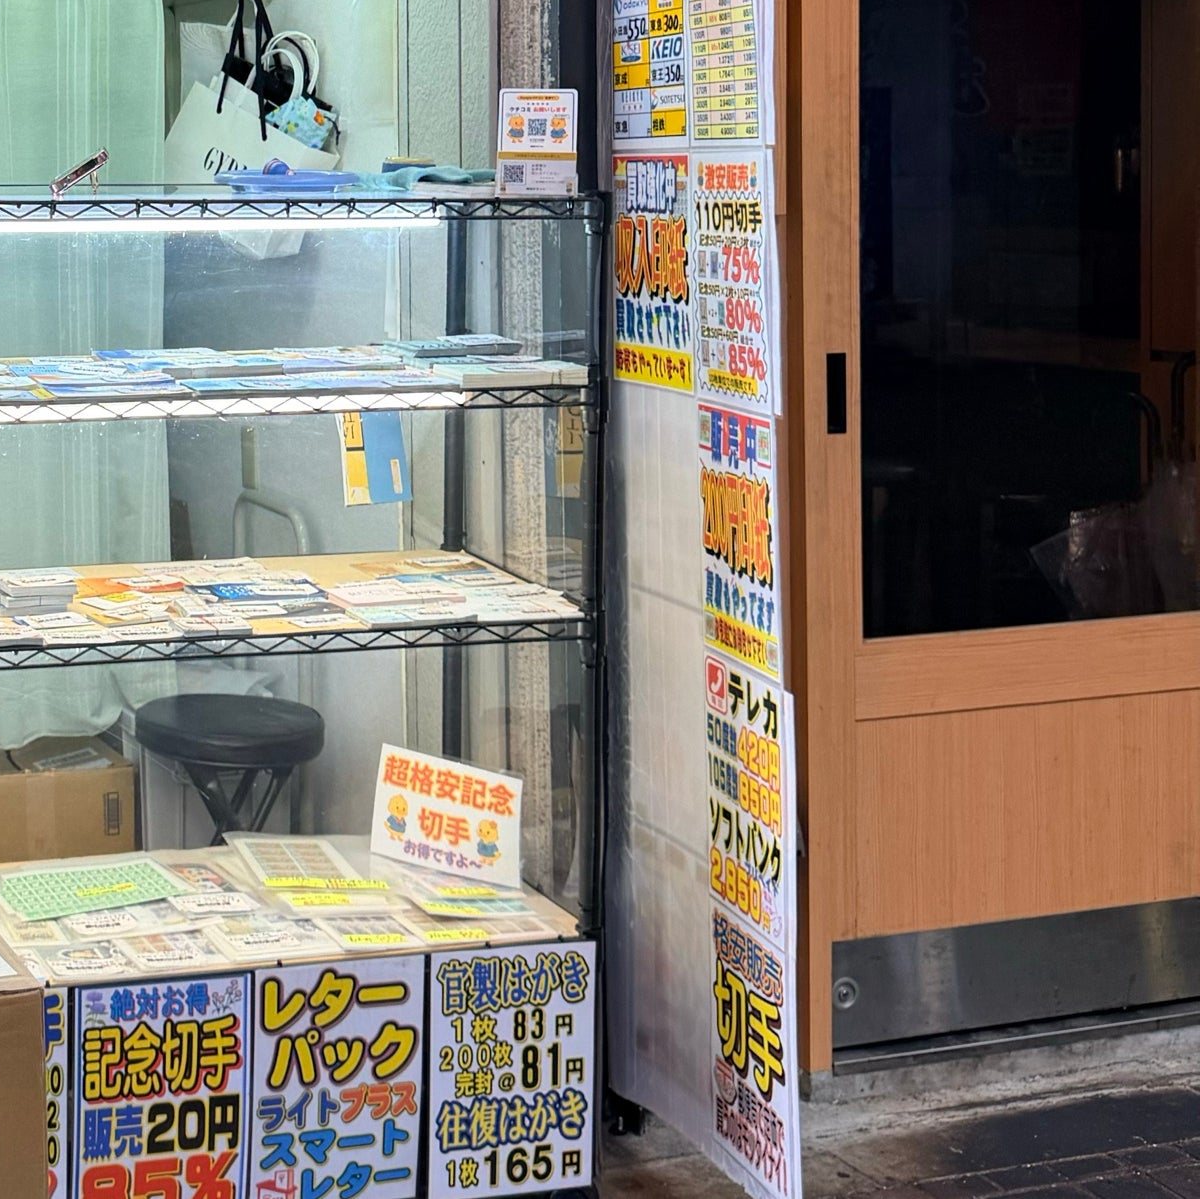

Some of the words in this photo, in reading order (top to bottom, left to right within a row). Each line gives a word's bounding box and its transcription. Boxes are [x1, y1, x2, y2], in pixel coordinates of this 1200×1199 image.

[652, 37, 682, 59] KEIO
[703, 163, 749, 192] 激安販売
[695, 201, 762, 234] 110円切手
[615, 212, 689, 304] 収入印紙
[722, 247, 760, 285] 75%
[616, 297, 691, 350] 買取させて下さい
[724, 297, 762, 334] 80%
[727, 343, 766, 382] 85%
[727, 670, 779, 740] テレカ
[383, 754, 516, 817] 超格安記念
[737, 726, 781, 792] 420円
[418, 806, 471, 846] 切手
[709, 796, 782, 885] ソフトバンク
[438, 950, 589, 1016] 官製はがき
[712, 908, 783, 1007] 格安販売
[109, 982, 210, 1022] 絶対お得
[260, 966, 411, 1033] レター
[266, 1020, 419, 1091] パック
[714, 956, 786, 1102] 切手
[83, 1014, 242, 1105] 記念切手
[439, 1041, 513, 1072] 200枚
[257, 1089, 340, 1132] ライト
[340, 1082, 418, 1122] プラス
[435, 1087, 589, 1153] 往復はがき
[259, 1119, 411, 1170] スマート
[299, 1160, 412, 1199] レター
